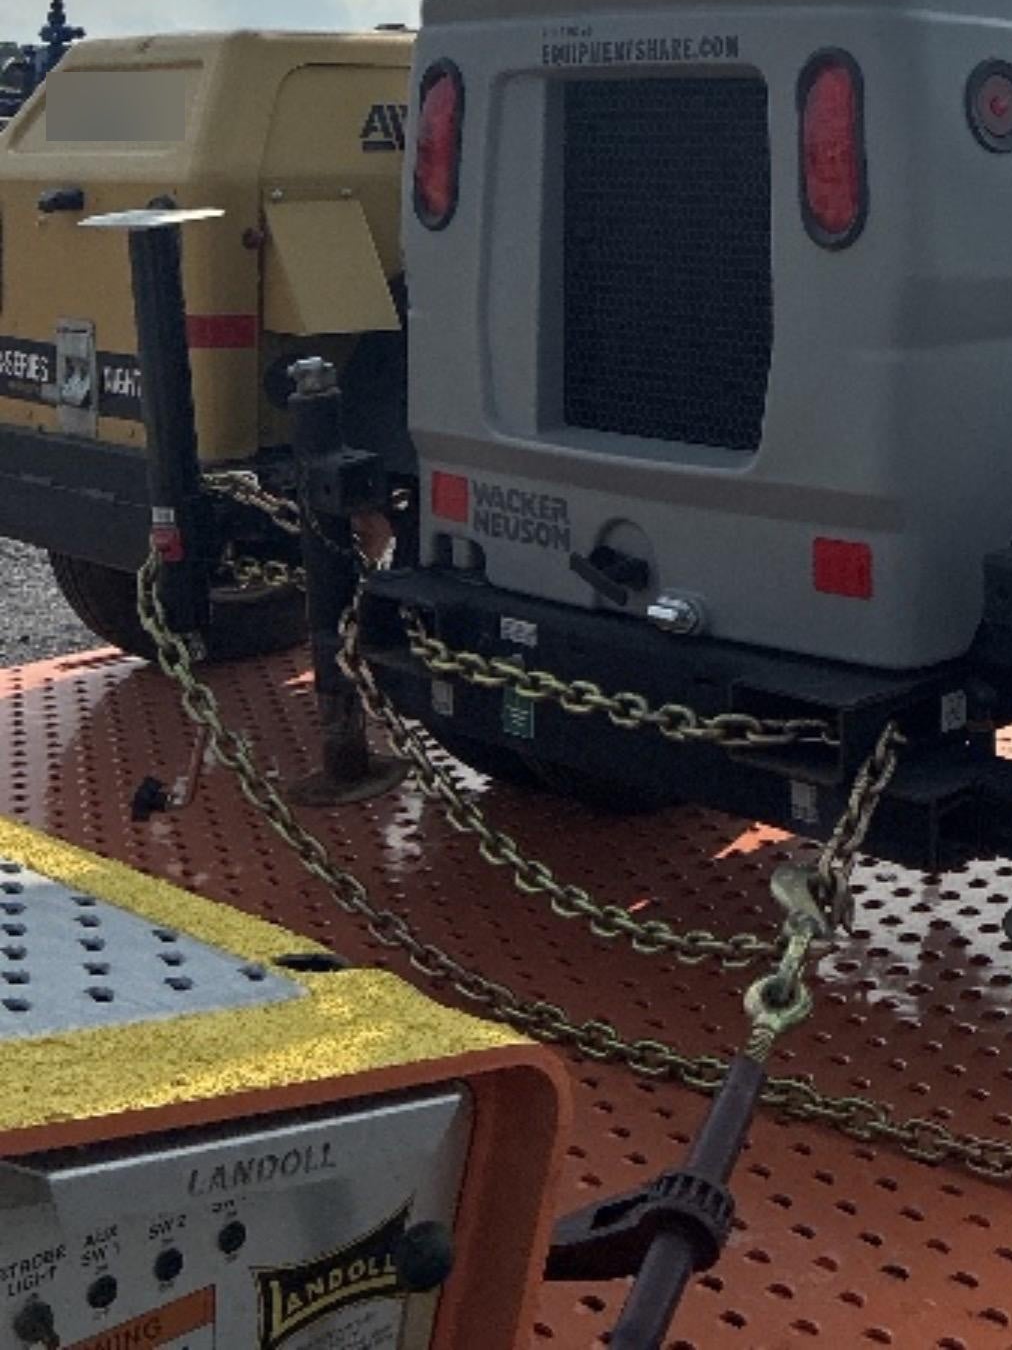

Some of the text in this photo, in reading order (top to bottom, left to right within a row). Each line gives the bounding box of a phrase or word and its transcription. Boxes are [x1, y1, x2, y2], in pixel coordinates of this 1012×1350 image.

[472, 480, 571, 524] WACKER
[473, 509, 571, 552] NEUSON
[187, 1141, 337, 1196] LANDOLL
[270, 1252, 398, 1337] LANDOLL
